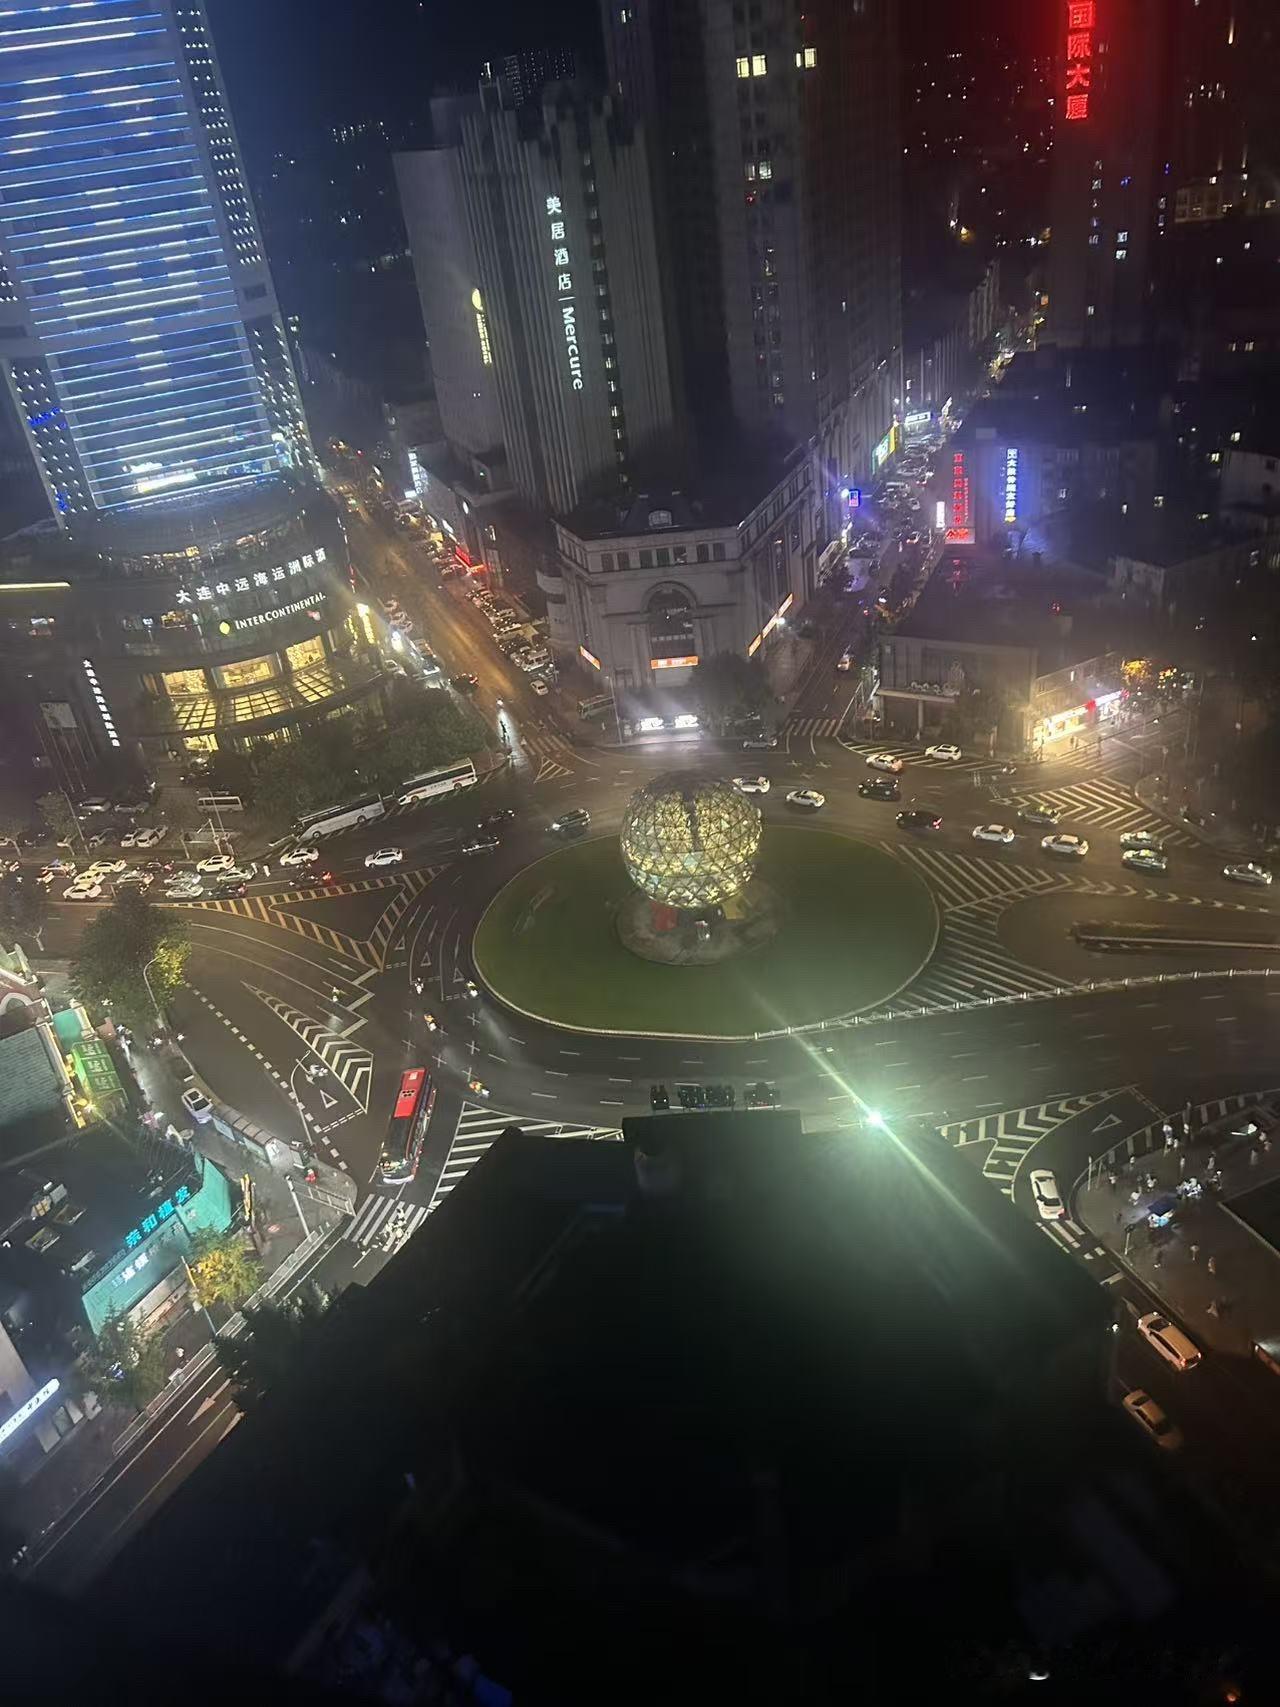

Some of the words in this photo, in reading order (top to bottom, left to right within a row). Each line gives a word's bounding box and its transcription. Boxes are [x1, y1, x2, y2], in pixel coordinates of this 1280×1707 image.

[1066, 2, 1095, 119] 国际大厦
[546, 196, 572, 290] 美居酒店
[562, 306, 584, 390] Mercure
[235, 591, 327, 630] INTERCONTINENTAL
